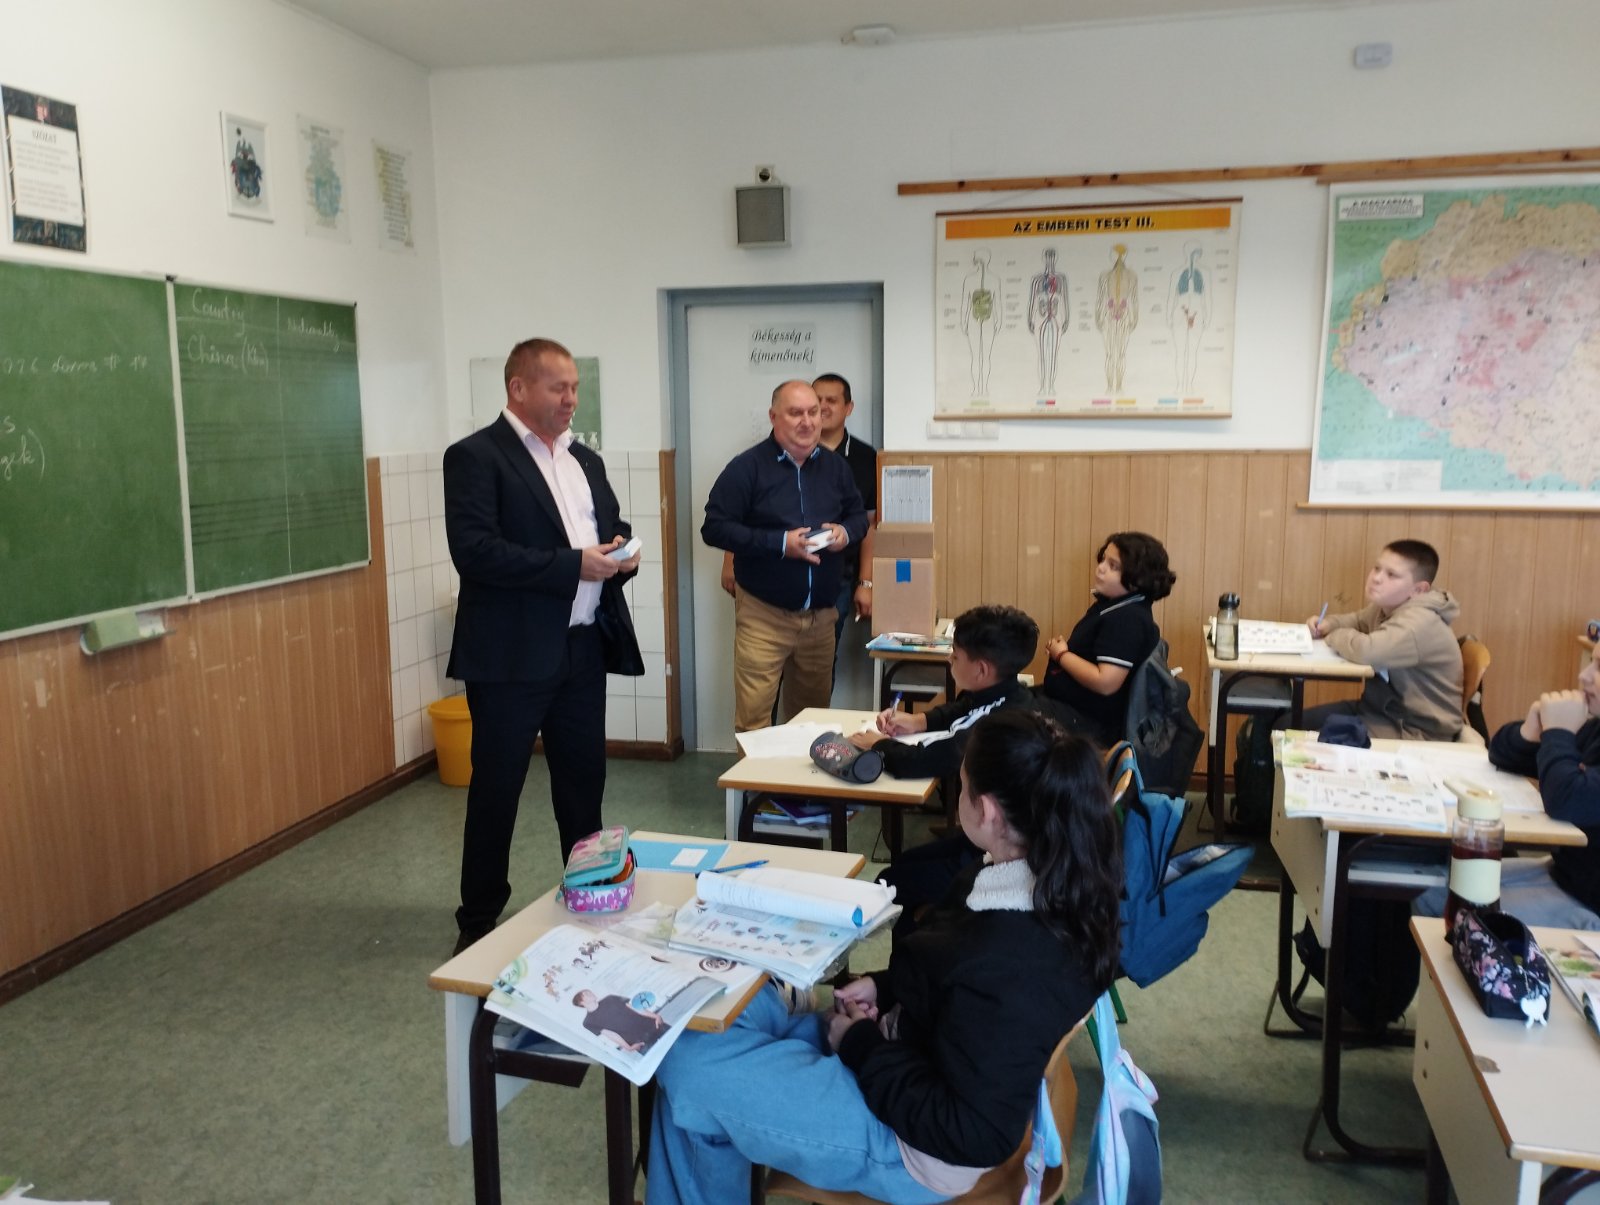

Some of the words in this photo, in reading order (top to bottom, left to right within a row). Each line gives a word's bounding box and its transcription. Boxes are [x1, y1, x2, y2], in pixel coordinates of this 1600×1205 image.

[1013, 221, 1032, 233] AZ
[1036, 218, 1090, 232] EMBERI
[1095, 216, 1132, 230] TEST
[1136, 215, 1156, 228] III.
[804, 331, 812, 342] a
